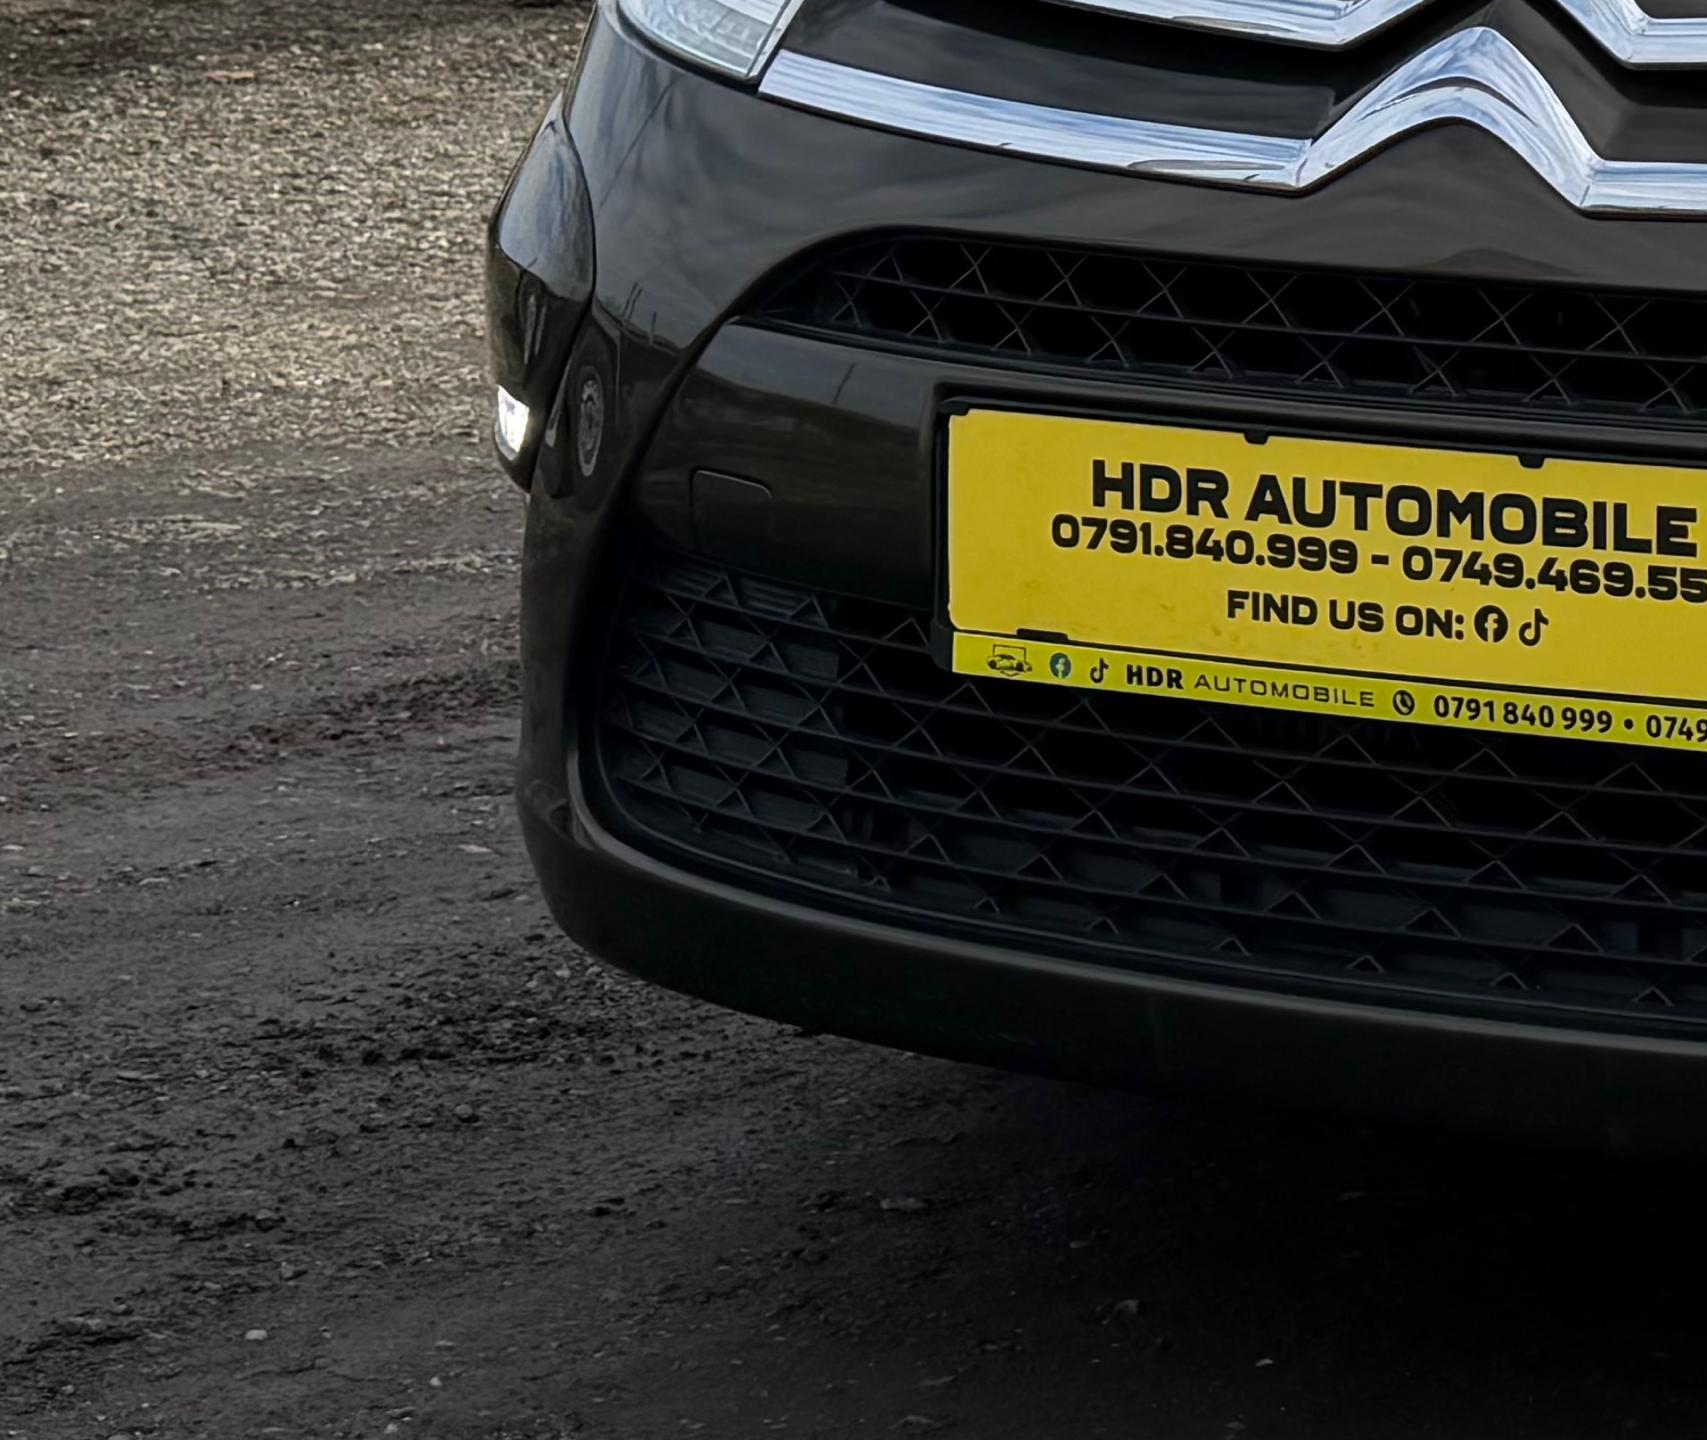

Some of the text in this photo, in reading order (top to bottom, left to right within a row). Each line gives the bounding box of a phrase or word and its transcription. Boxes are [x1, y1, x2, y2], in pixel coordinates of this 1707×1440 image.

[1092, 459, 1698, 558] HDR AUTOMOBILE
[1052, 514, 1358, 574] 0791.840.999
[1371, 554, 1389, 565] -
[1227, 589, 1464, 640] FIND US ON:
[1126, 664, 1376, 708] HDR AUTOMOBILE
[1434, 695, 1496, 722] 0791
[1502, 701, 1555, 729] 840
[1562, 707, 1613, 734] 999
